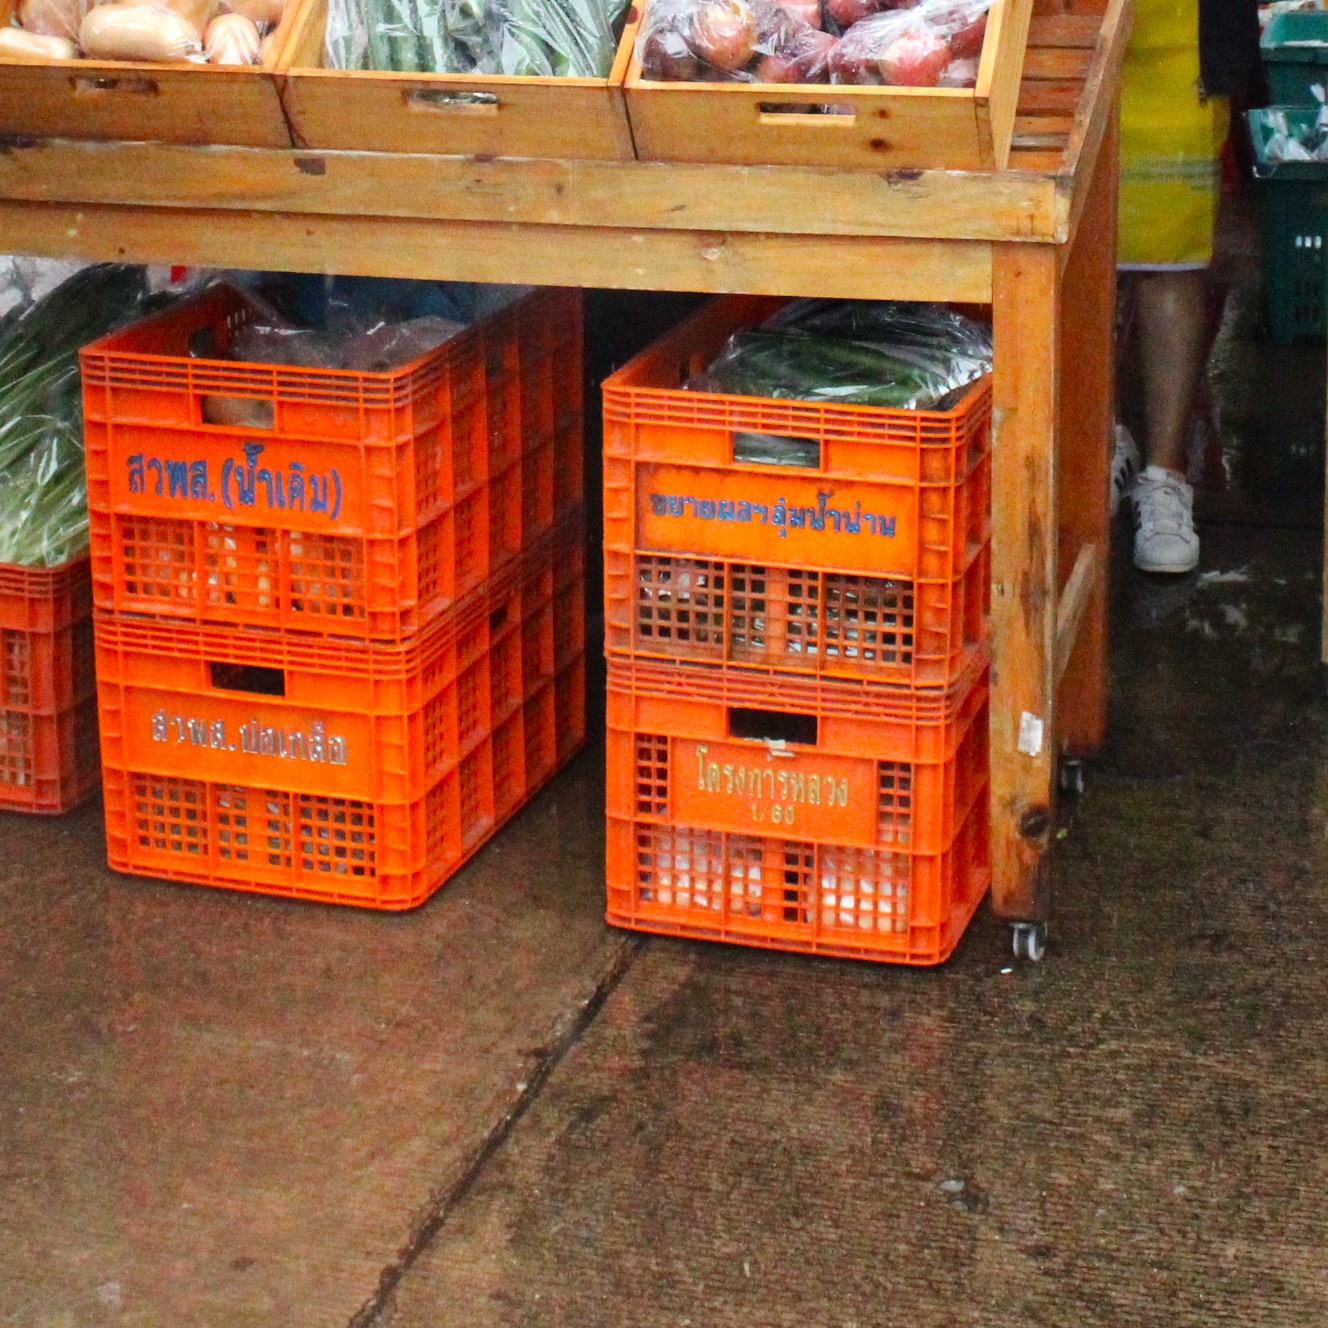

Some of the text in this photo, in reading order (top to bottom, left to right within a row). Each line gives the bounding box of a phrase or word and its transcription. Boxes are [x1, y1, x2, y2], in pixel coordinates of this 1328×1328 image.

[695, 745, 849, 808] โครงการหลวง
